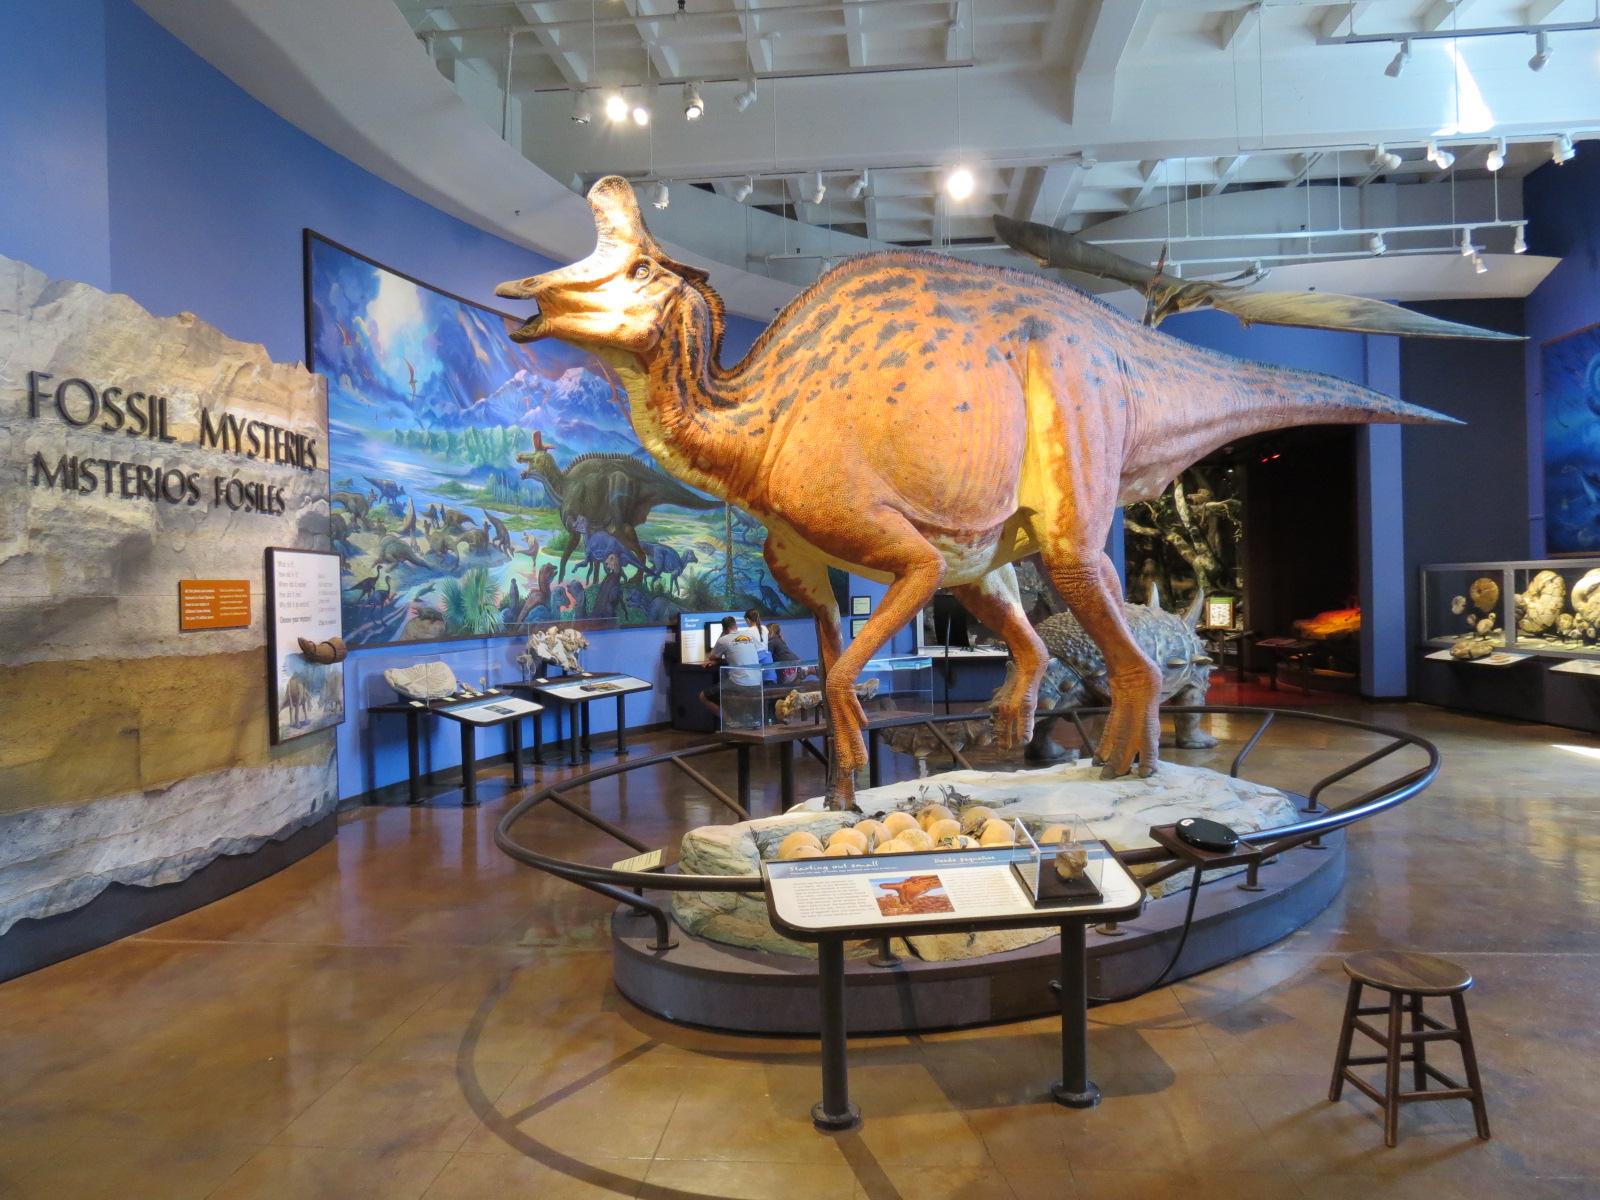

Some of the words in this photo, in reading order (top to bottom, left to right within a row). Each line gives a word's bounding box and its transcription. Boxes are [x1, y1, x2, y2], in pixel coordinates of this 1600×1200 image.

[28, 370, 177, 442] FOSSIL
[199, 407, 318, 471] MYSTERIES
[33, 450, 201, 505] MISTERIOS
[214, 467, 286, 514] FÓSILES
[789, 865, 829, 873] Starting
[851, 860, 879, 868] small
